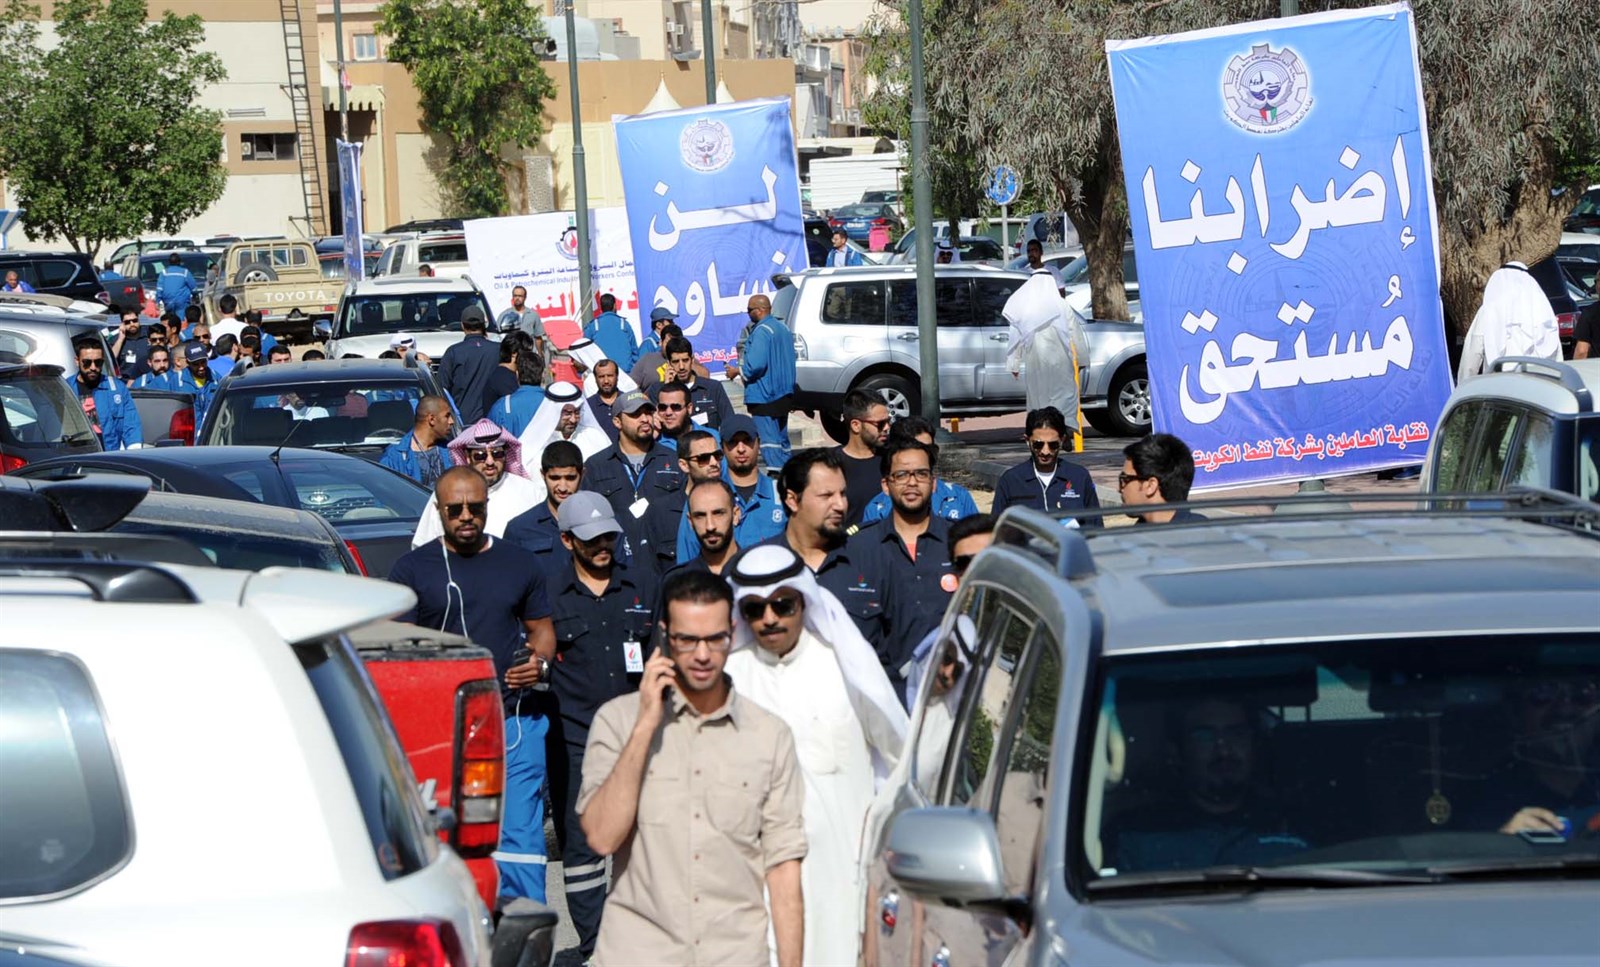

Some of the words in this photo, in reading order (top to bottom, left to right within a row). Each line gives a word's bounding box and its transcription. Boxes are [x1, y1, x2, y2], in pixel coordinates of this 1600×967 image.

[648, 163, 778, 252] لن
[1141, 134, 1417, 276] إضرابنا
[264, 290, 327, 303] TOYOTA
[1273, 433, 1326, 461] بشركة
[1326, 428, 1385, 457] العاملين
[1386, 422, 1430, 450] نقابة
[1193, 444, 1242, 472] الكويت
[1242, 440, 1274, 463] نفط
